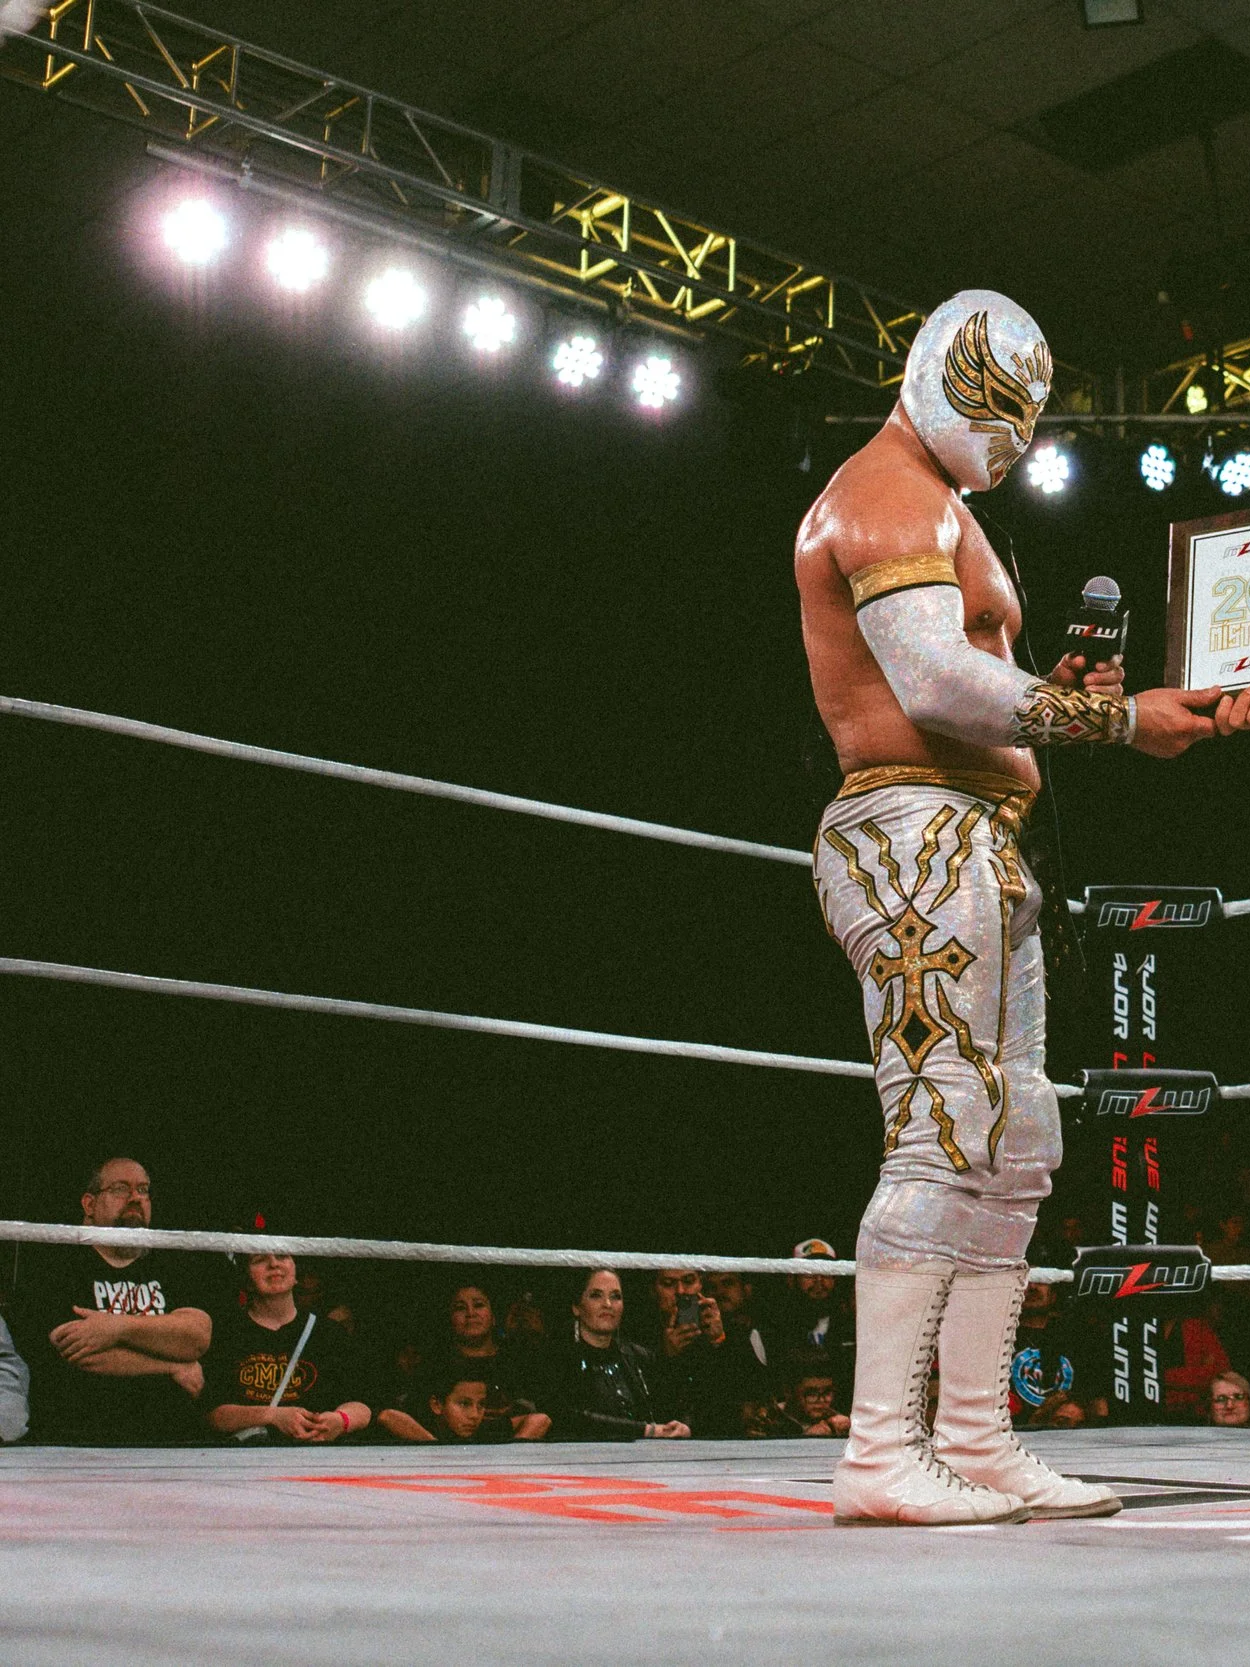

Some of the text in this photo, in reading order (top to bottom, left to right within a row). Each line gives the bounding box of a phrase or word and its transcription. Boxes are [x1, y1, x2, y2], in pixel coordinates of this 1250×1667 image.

[1066, 624, 1119, 639] MLW
[1097, 900, 1211, 931] MLW
[1113, 953, 1129, 1040] AJOR
[1097, 1087, 1211, 1118] MLW
[1077, 1262, 1209, 1299] MLW
